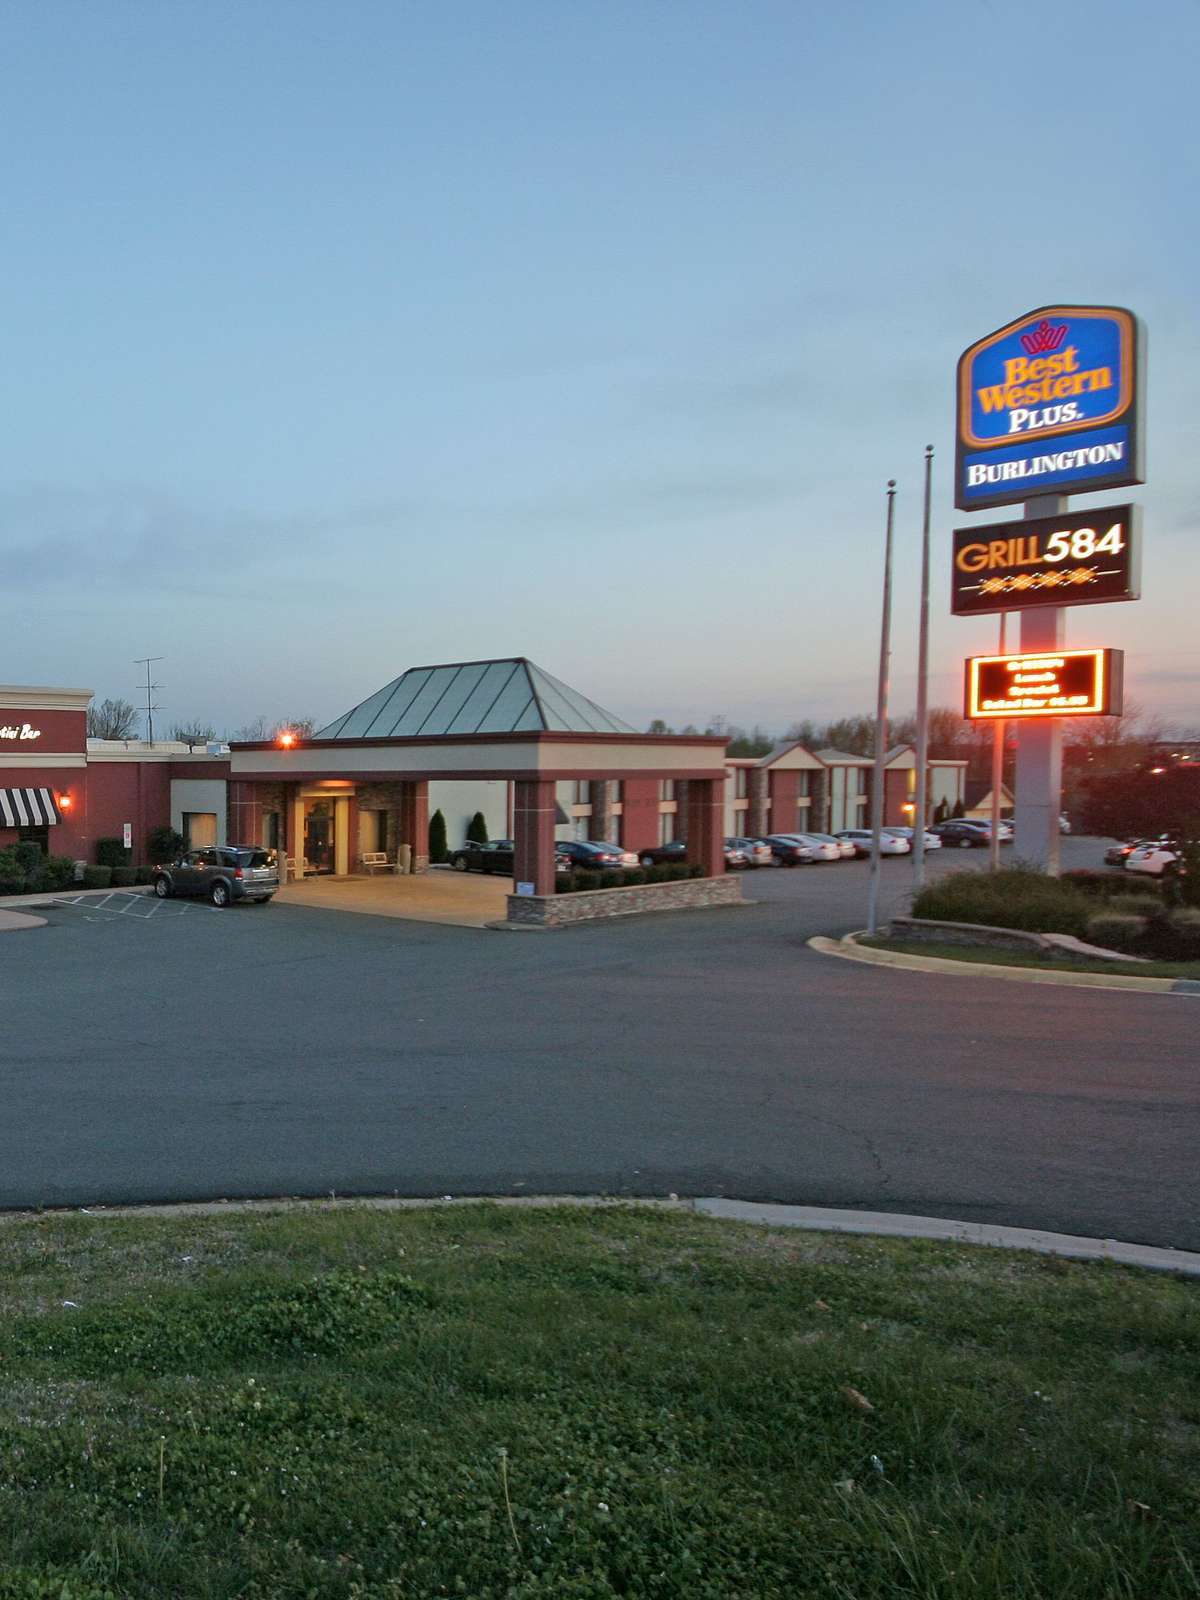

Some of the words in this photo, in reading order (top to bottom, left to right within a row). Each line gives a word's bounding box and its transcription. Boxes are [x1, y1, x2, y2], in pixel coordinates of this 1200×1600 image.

[1003, 346, 1080, 387] Best
[977, 367, 1112, 414] Western
[967, 442, 1125, 486] BURLINGTON
[956, 536, 1043, 572] GRILL
[1043, 523, 1126, 562] 584
[0, 726, 19, 739] tini
